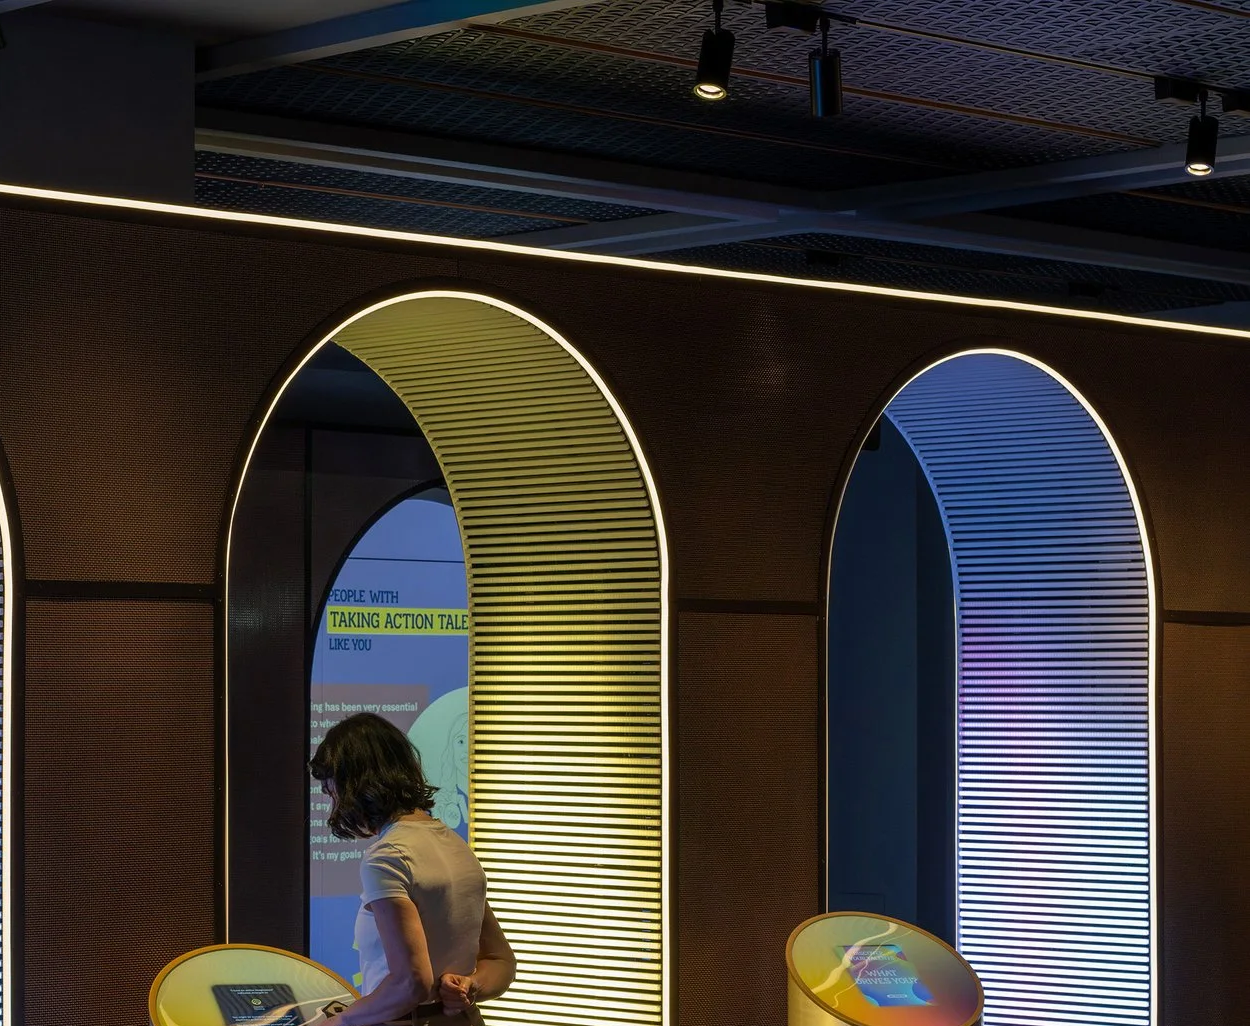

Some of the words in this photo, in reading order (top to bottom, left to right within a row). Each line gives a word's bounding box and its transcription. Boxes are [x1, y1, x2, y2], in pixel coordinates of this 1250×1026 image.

[369, 590, 399, 603] WITH
[330, 611, 380, 628] TAKING
[384, 612, 434, 629] ACTION
[329, 638, 350, 651] LIKE
[352, 639, 372, 651] YOU
[325, 702, 340, 711] has
[342, 702, 362, 711] been
[363, 704, 380, 713] very
[382, 702, 418, 712] essential
[327, 852, 339, 861] my
[340, 849, 362, 862] goals
[865, 969, 897, 977] WHAT
